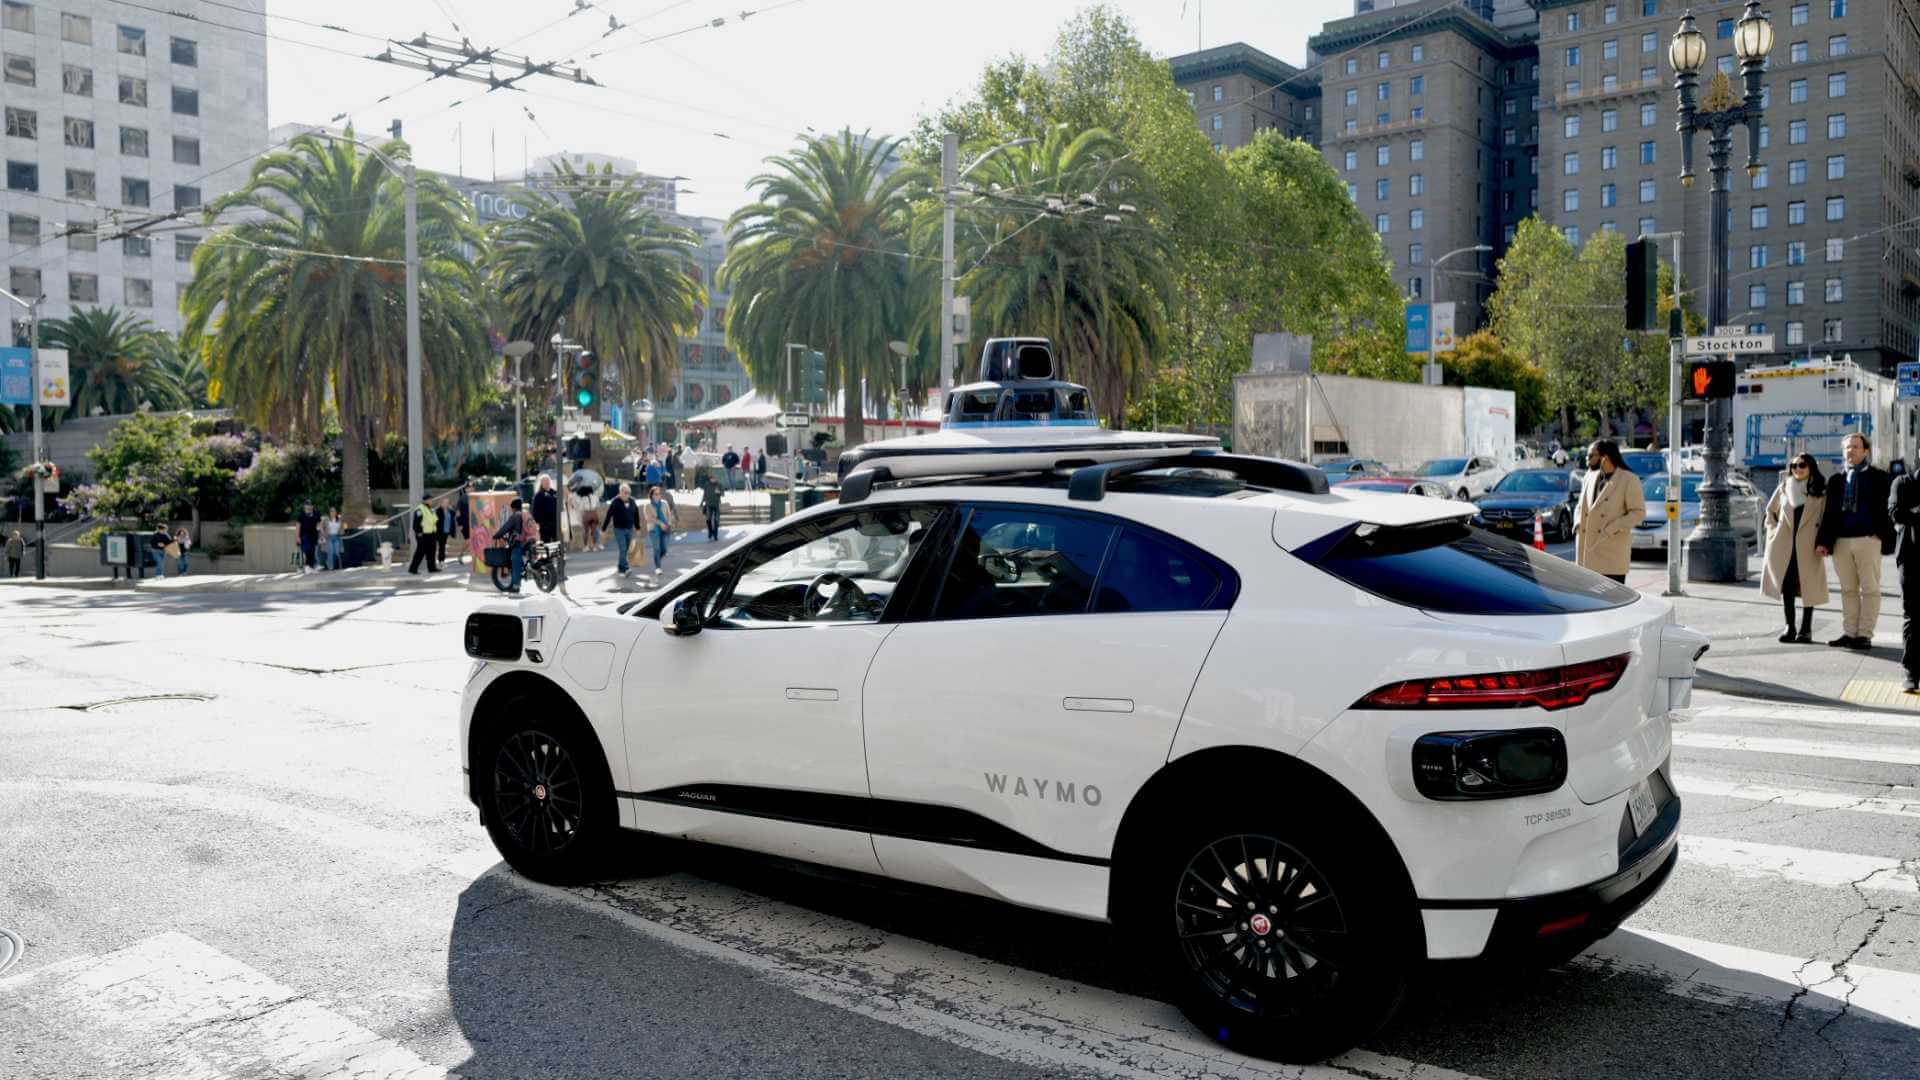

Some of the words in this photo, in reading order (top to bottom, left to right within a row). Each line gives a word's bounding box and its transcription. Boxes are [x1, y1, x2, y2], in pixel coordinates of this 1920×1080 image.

[1697, 339, 1763, 351] Stockton
[983, 772, 1102, 806] WAYMO
[678, 791, 717, 802] JAGUAR
[1524, 812, 1543, 826] TCP
